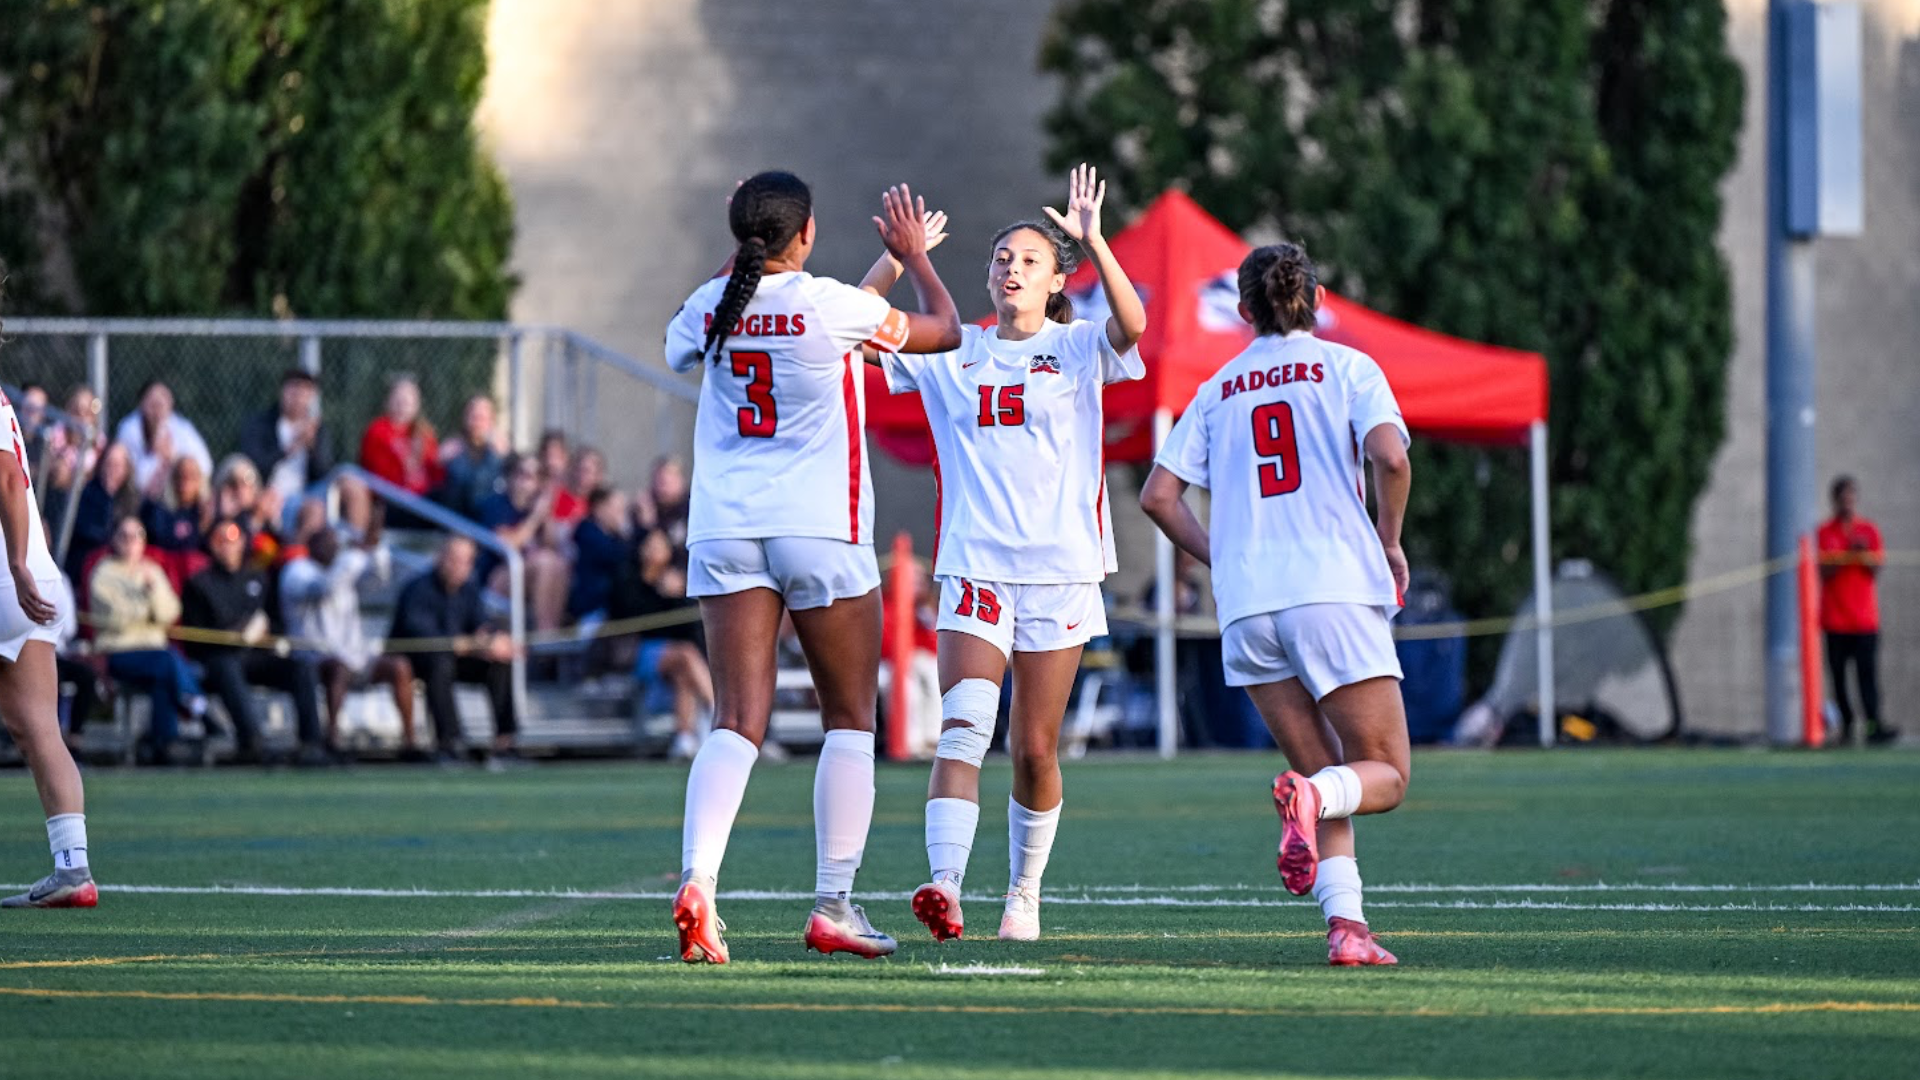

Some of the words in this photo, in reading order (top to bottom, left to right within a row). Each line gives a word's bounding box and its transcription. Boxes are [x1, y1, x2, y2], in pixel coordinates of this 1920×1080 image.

[703, 312, 806, 336] DGERS
[730, 350, 777, 438] 3
[1221, 362, 1324, 401] BADGERS
[977, 383, 1025, 427] 15
[1251, 400, 1302, 498] 9
